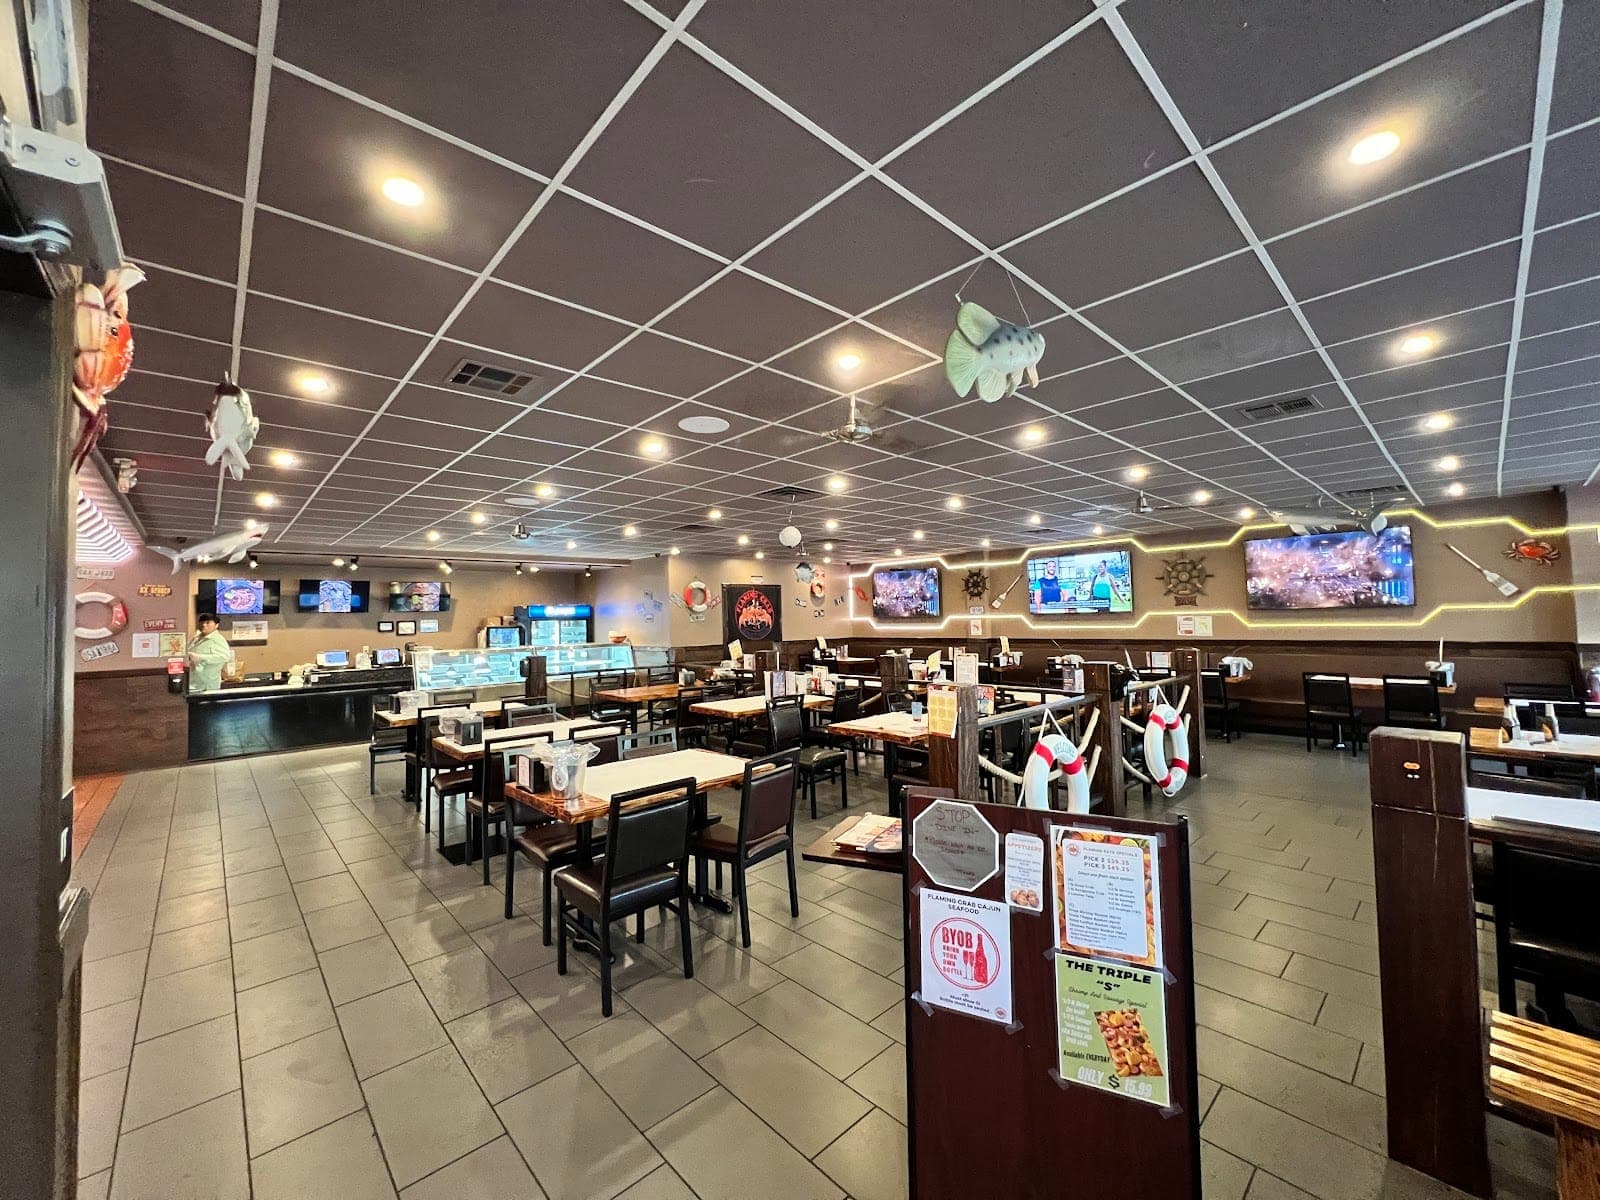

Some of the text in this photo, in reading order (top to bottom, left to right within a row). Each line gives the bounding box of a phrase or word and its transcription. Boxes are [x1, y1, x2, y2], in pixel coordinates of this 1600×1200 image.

[934, 806, 970, 824] STOP
[927, 893, 1001, 913] FLAMING CRAB CAJUN
[948, 904, 980, 915] SEAFOOD
[941, 926, 973, 949] BYOB
[1065, 959, 1152, 984] THE TRIPLE
[1077, 1065, 1105, 1085] ONLY
